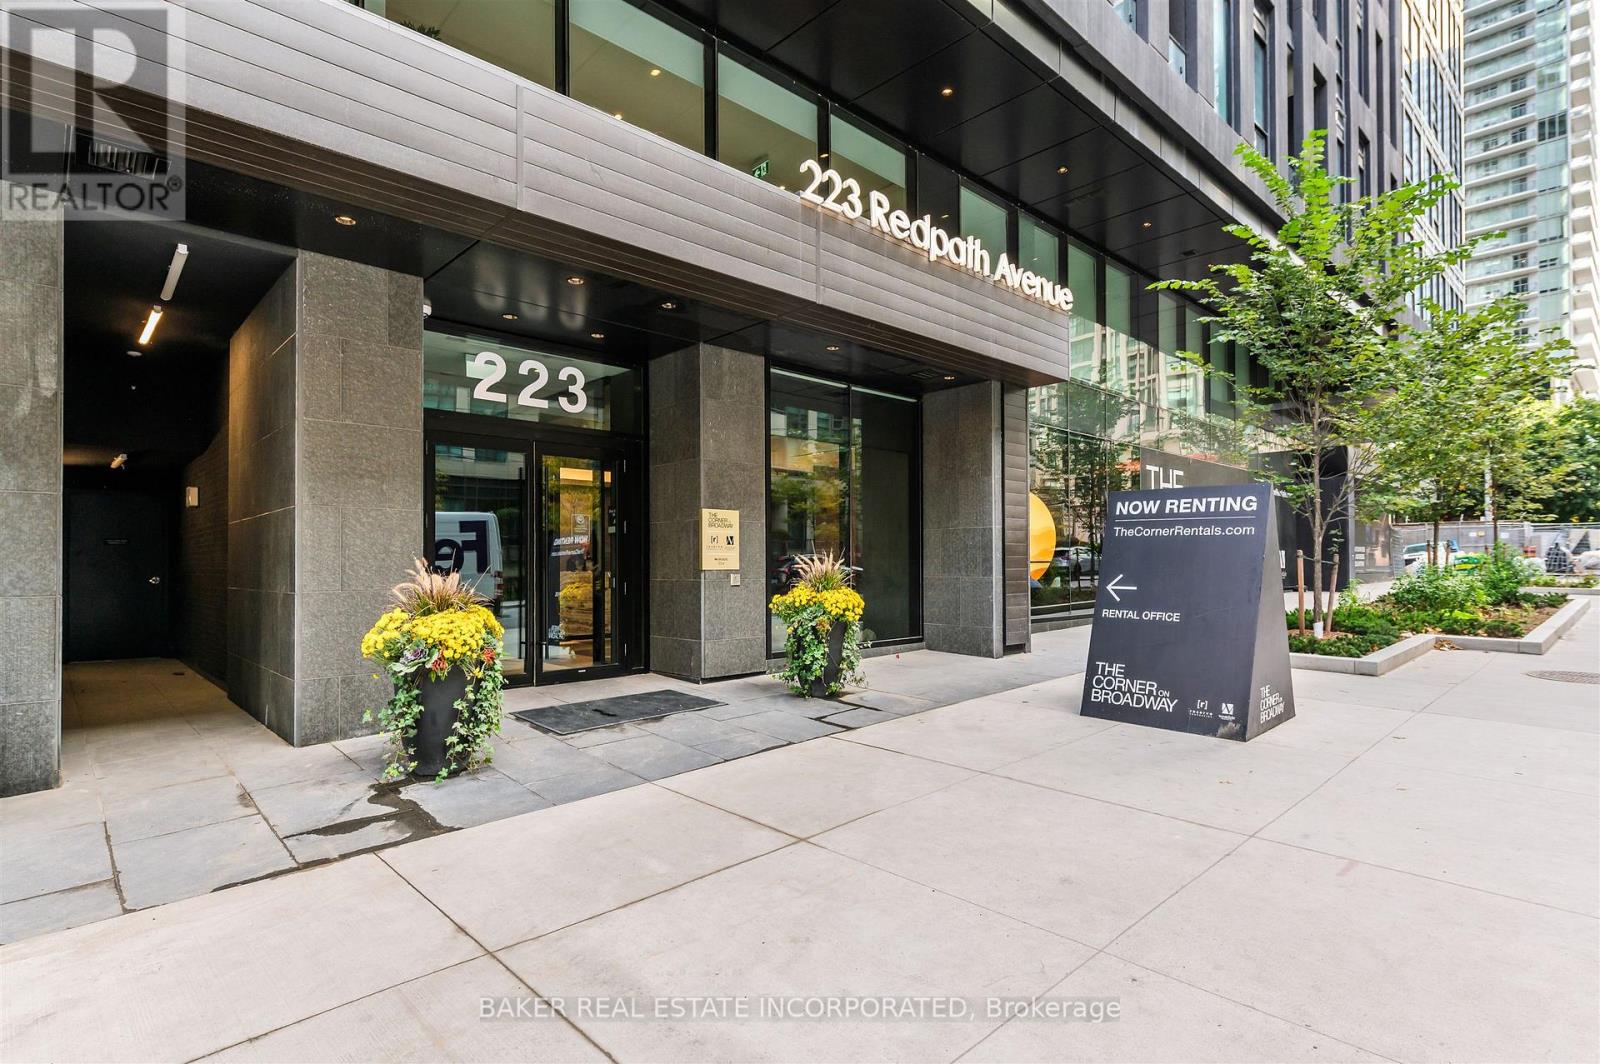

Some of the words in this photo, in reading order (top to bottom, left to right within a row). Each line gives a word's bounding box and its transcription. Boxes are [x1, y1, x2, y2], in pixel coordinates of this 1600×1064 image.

[800, 159, 863, 219] 223
[869, 190, 991, 277] Redpath
[993, 252, 1074, 311] Avenue
[473, 351, 588, 414] 223
[1145, 465, 1185, 490] THE
[1115, 501, 1160, 515] NOW
[1165, 496, 1258, 514] RENTING
[1114, 525, 1256, 537] TheCornerRentals.com
[1102, 609, 1140, 620] RENTAL
[1142, 611, 1181, 622] OFFICE
[1095, 661, 1126, 677] THE
[1092, 675, 1158, 695] CORNER
[1158, 689, 1170, 698] ON
[1091, 688, 1178, 712] BROADWAY
